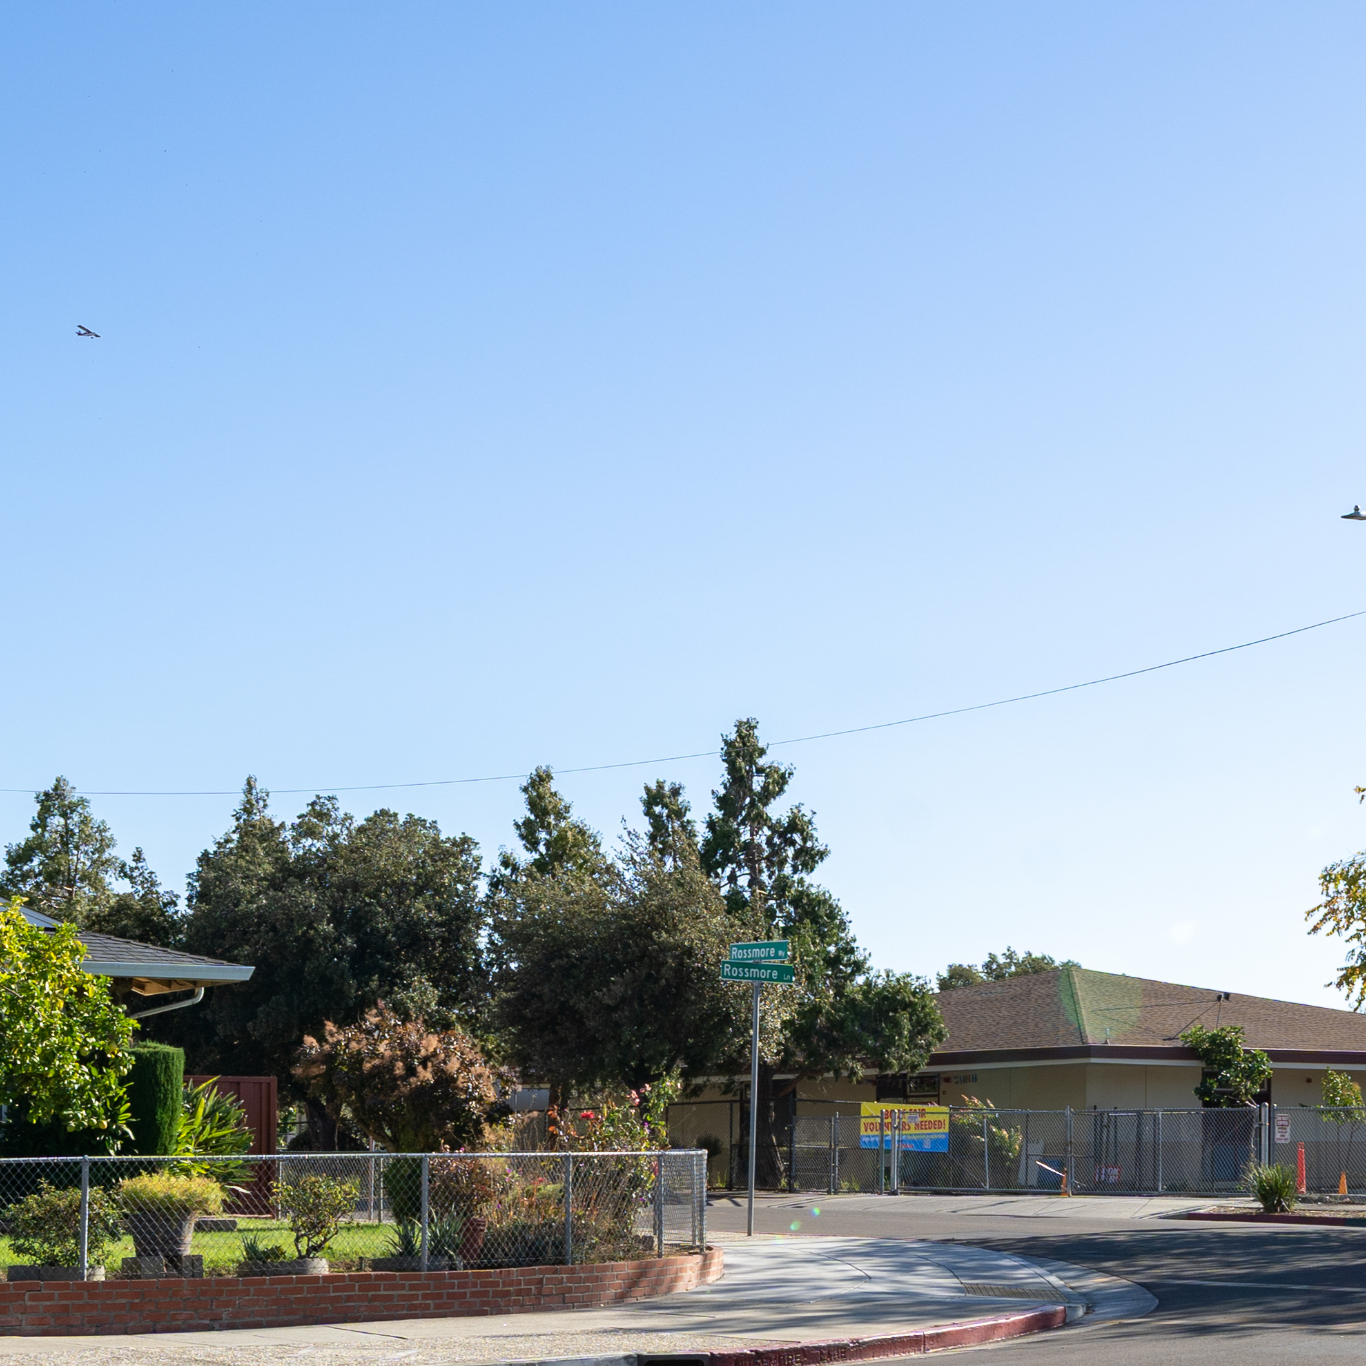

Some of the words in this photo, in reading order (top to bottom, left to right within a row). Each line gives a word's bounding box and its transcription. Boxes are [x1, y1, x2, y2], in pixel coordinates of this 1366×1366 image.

[732, 947, 775, 959] Rossmore
[724, 964, 778, 979] Rossmore
[863, 1121, 911, 1132] VOLNTRS
